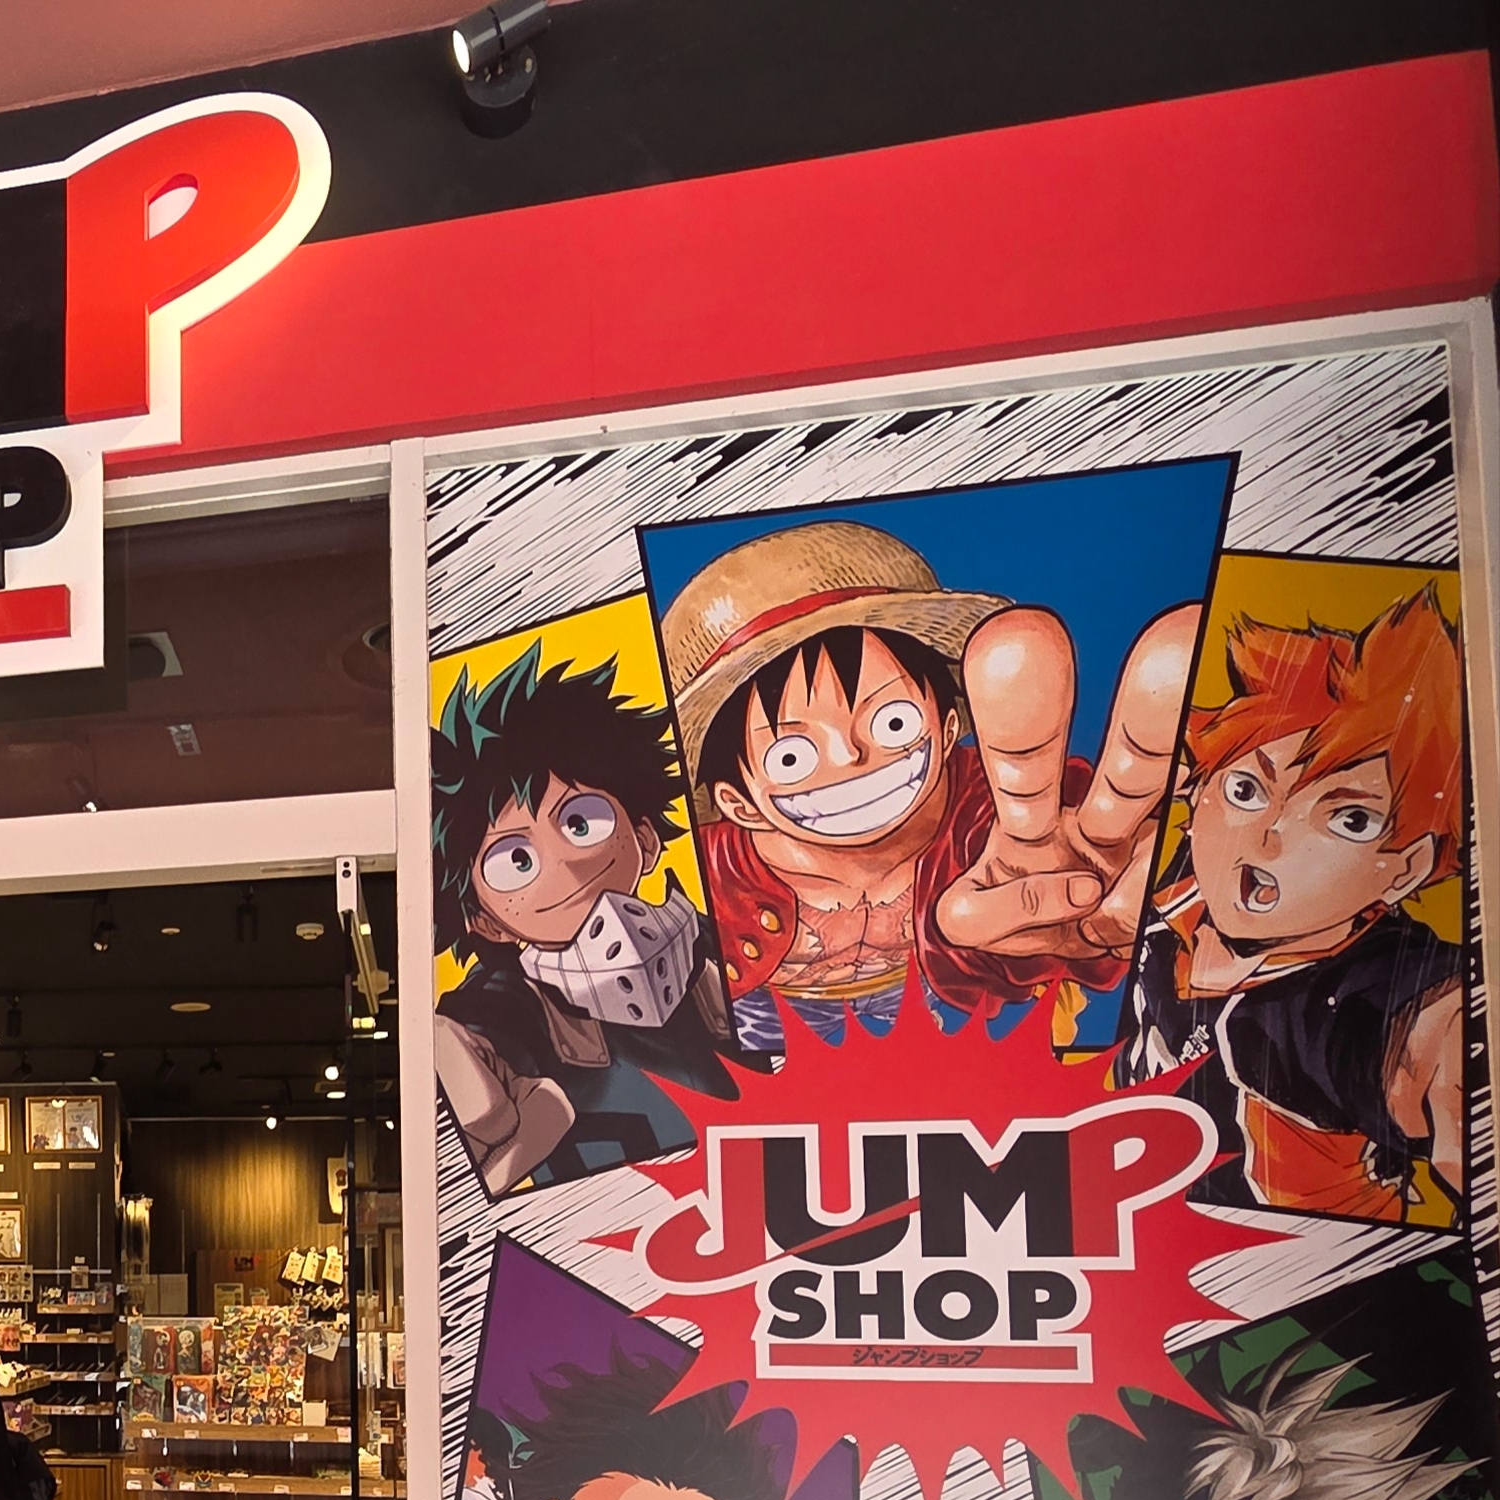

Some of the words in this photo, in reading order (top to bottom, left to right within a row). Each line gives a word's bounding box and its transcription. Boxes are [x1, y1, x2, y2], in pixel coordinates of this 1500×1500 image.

[644, 1107, 1206, 1283] JUMP
[766, 1269, 1079, 1342] SHOP
[852, 1346, 985, 1366] ジャンプショップ
